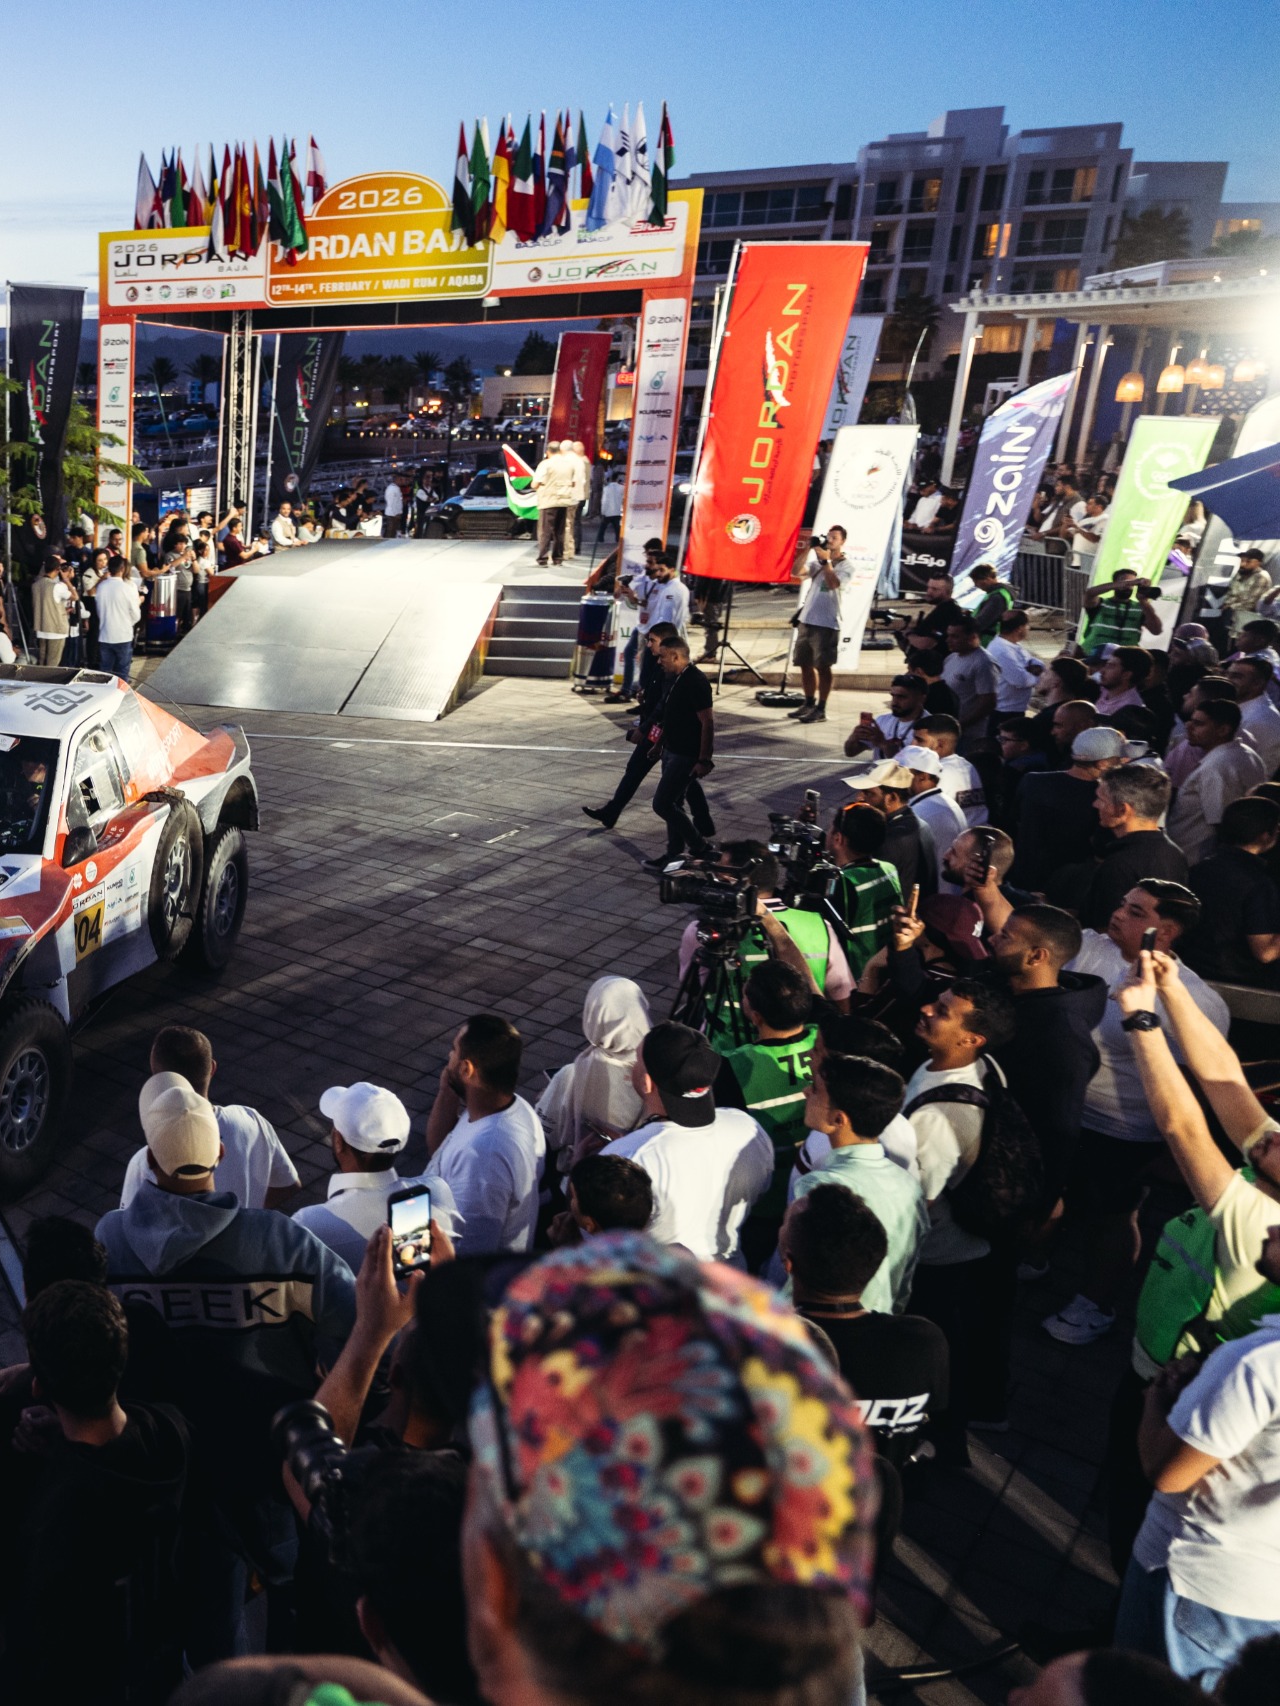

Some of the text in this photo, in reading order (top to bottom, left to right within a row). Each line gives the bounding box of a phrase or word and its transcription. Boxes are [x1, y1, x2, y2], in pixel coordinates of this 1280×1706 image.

[338, 186, 423, 211] 2026
[114, 243, 158, 254] 2026
[274, 231, 396, 263] JRDAN
[114, 252, 249, 268] JORDAN
[217, 265, 249, 273] BAJA
[548, 261, 657, 279] JORDAN
[319, 280, 372, 293] FEBRUARY
[382, 278, 410, 290] WADI
[413, 276, 437, 289] RUM
[448, 274, 484, 287] AQABA
[45, 321, 61, 413] MOTORSPORT
[742, 283, 807, 504] JORDAN
[985, 426, 1036, 516] zain
[72, 889, 103, 910] ORDAN
[74, 907, 102, 954] 04
